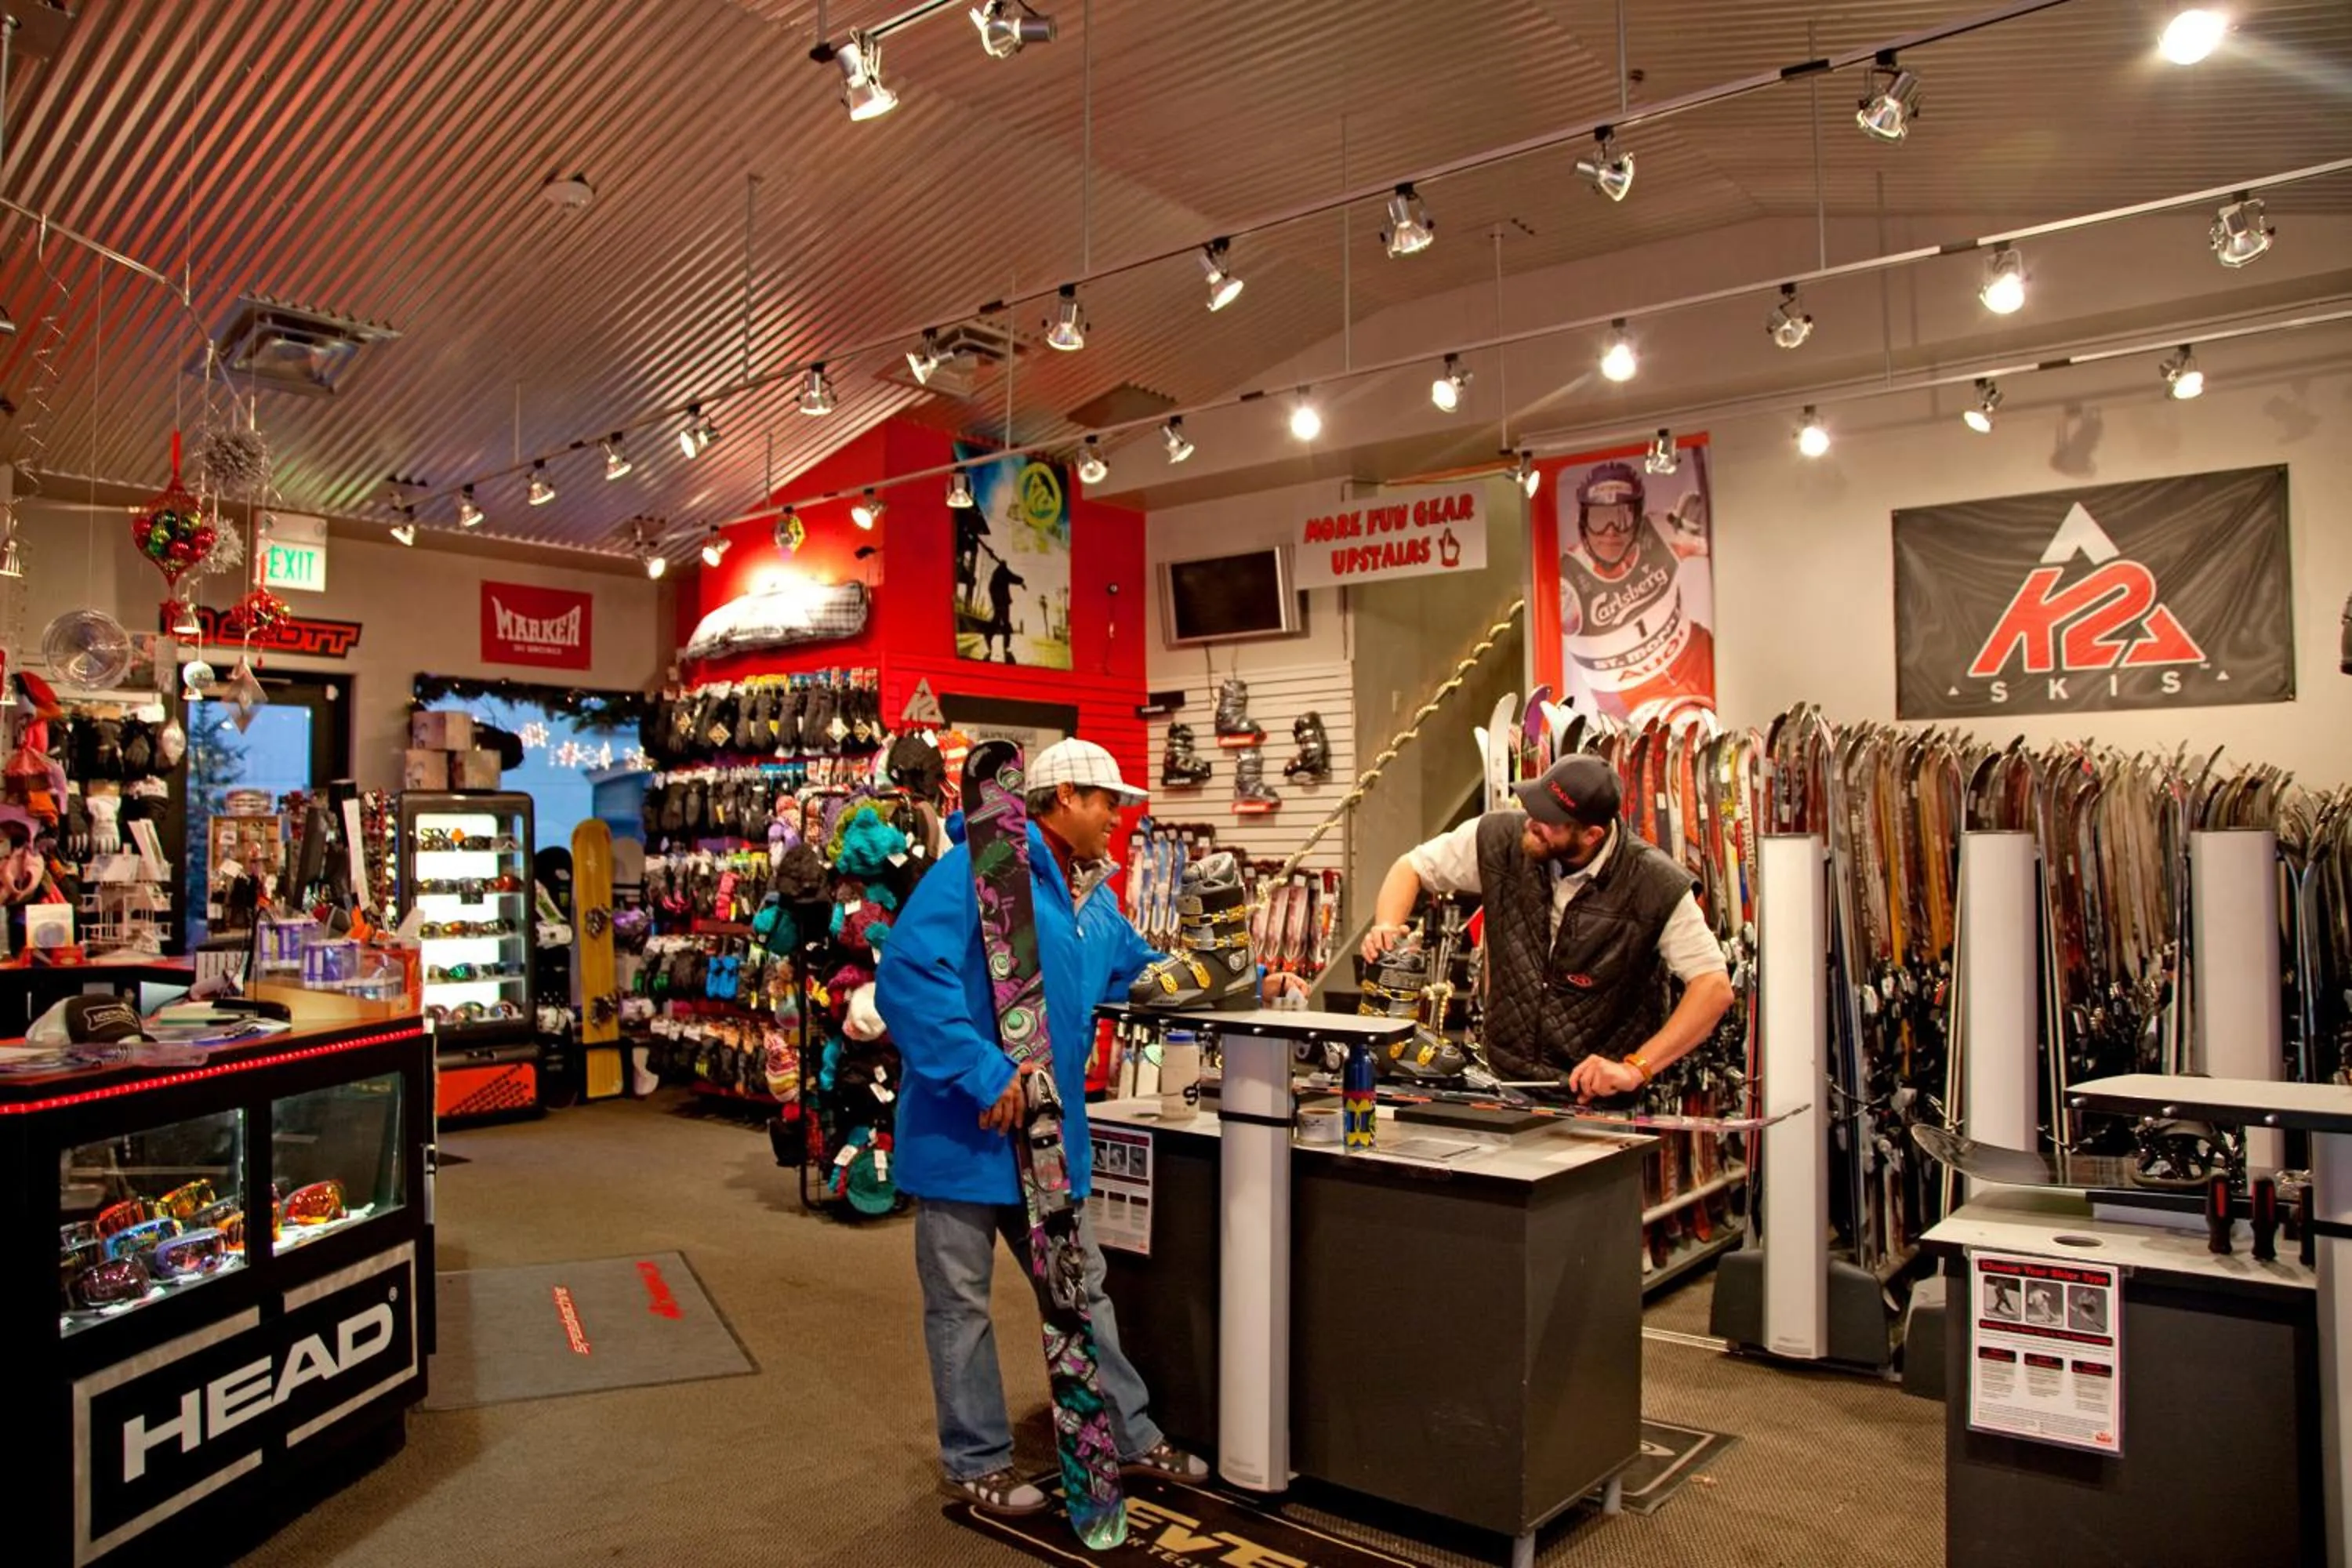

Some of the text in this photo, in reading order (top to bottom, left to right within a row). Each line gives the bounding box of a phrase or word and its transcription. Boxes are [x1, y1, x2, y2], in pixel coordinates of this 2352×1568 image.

[1304, 493, 1474, 543] MORE FUN GEAR
[269, 545, 317, 582] EXIT
[1330, 535, 1431, 575] UPSTAIRS
[1590, 567, 1669, 626] Carlsberg
[1967, 559, 2206, 677] K2
[220, 616, 354, 652] SOTT
[491, 596, 582, 646] MARKER
[1634, 617, 1648, 639] 1
[1990, 671, 2181, 702] SKIS
[123, 1302, 394, 1483] HEAD
